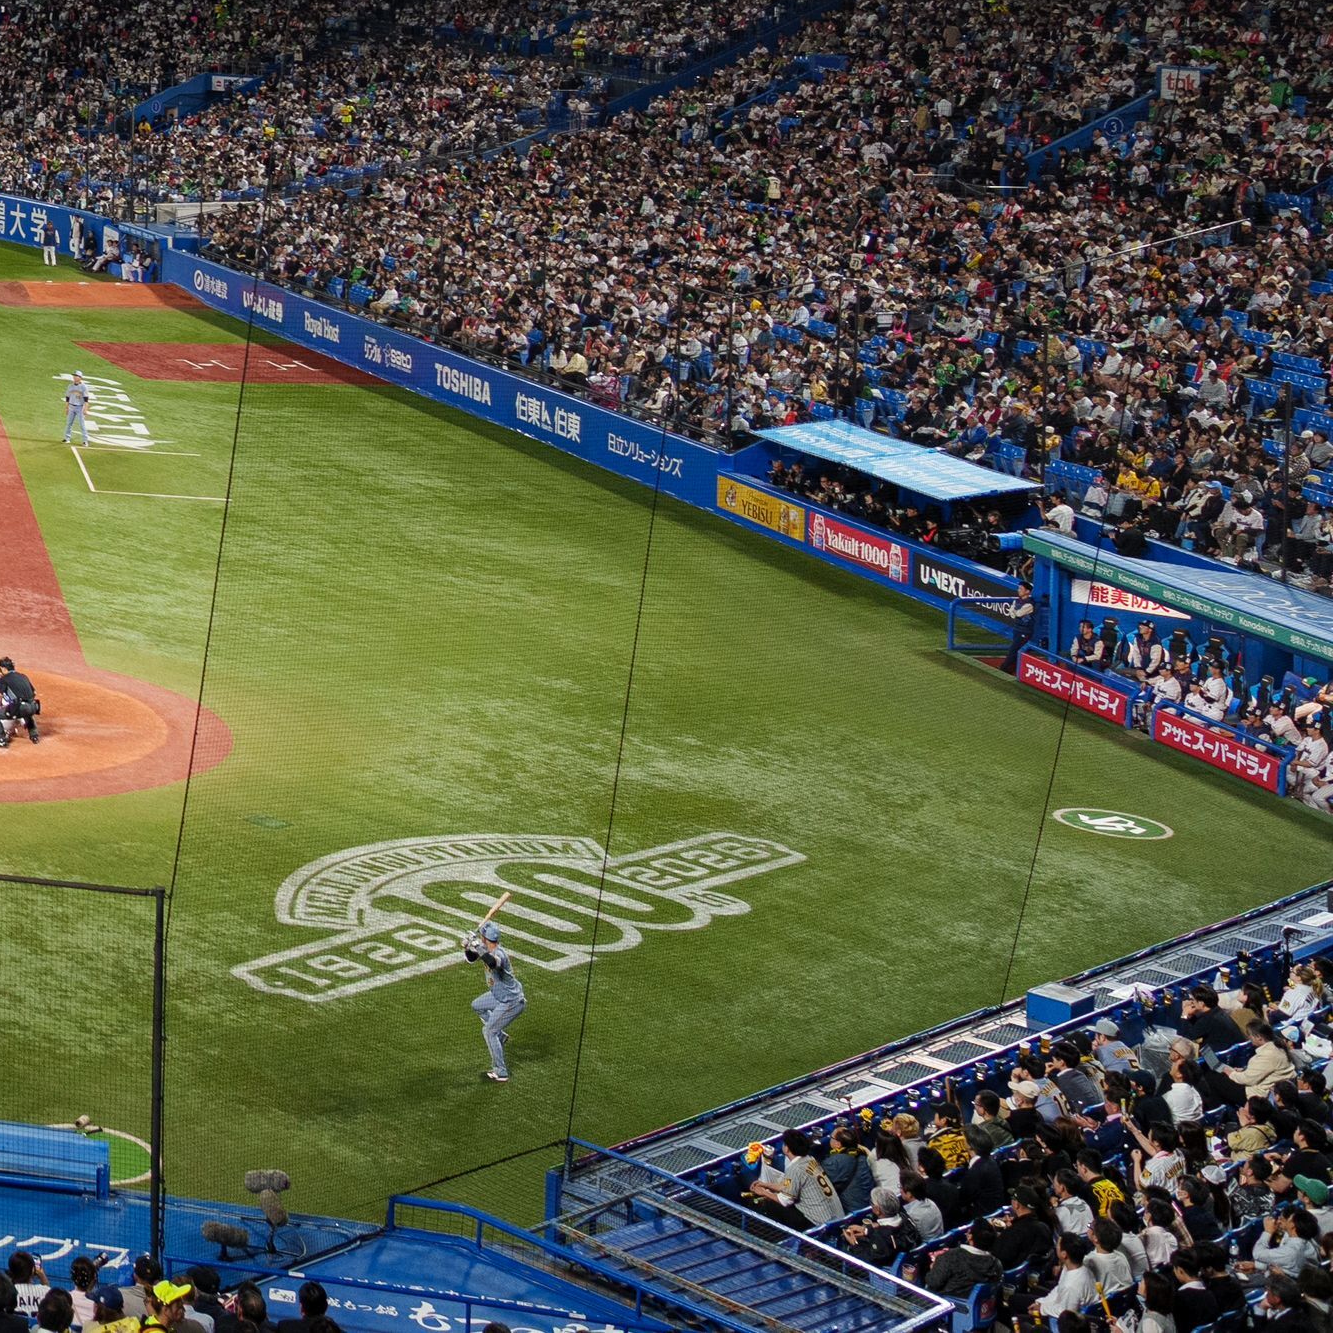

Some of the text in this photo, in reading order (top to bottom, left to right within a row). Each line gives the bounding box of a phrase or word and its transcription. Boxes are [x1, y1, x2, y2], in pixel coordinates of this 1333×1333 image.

[304, 311, 340, 343] Royal Host
[434, 362, 492, 406] TOSHIBA
[553, 406, 581, 444] 伯東
[607, 432, 683, 479] 日立ソリューションズ
[741, 499, 773, 525] YEBISU
[1118, 573, 1150, 592] Kanadevia
[1238, 616, 1275, 637] Kanadevia
[1024, 662, 1120, 715] アサヒスーパードライ
[1161, 721, 1271, 782] アサヒスーパードライ
[622, 840, 774, 887] 2026
